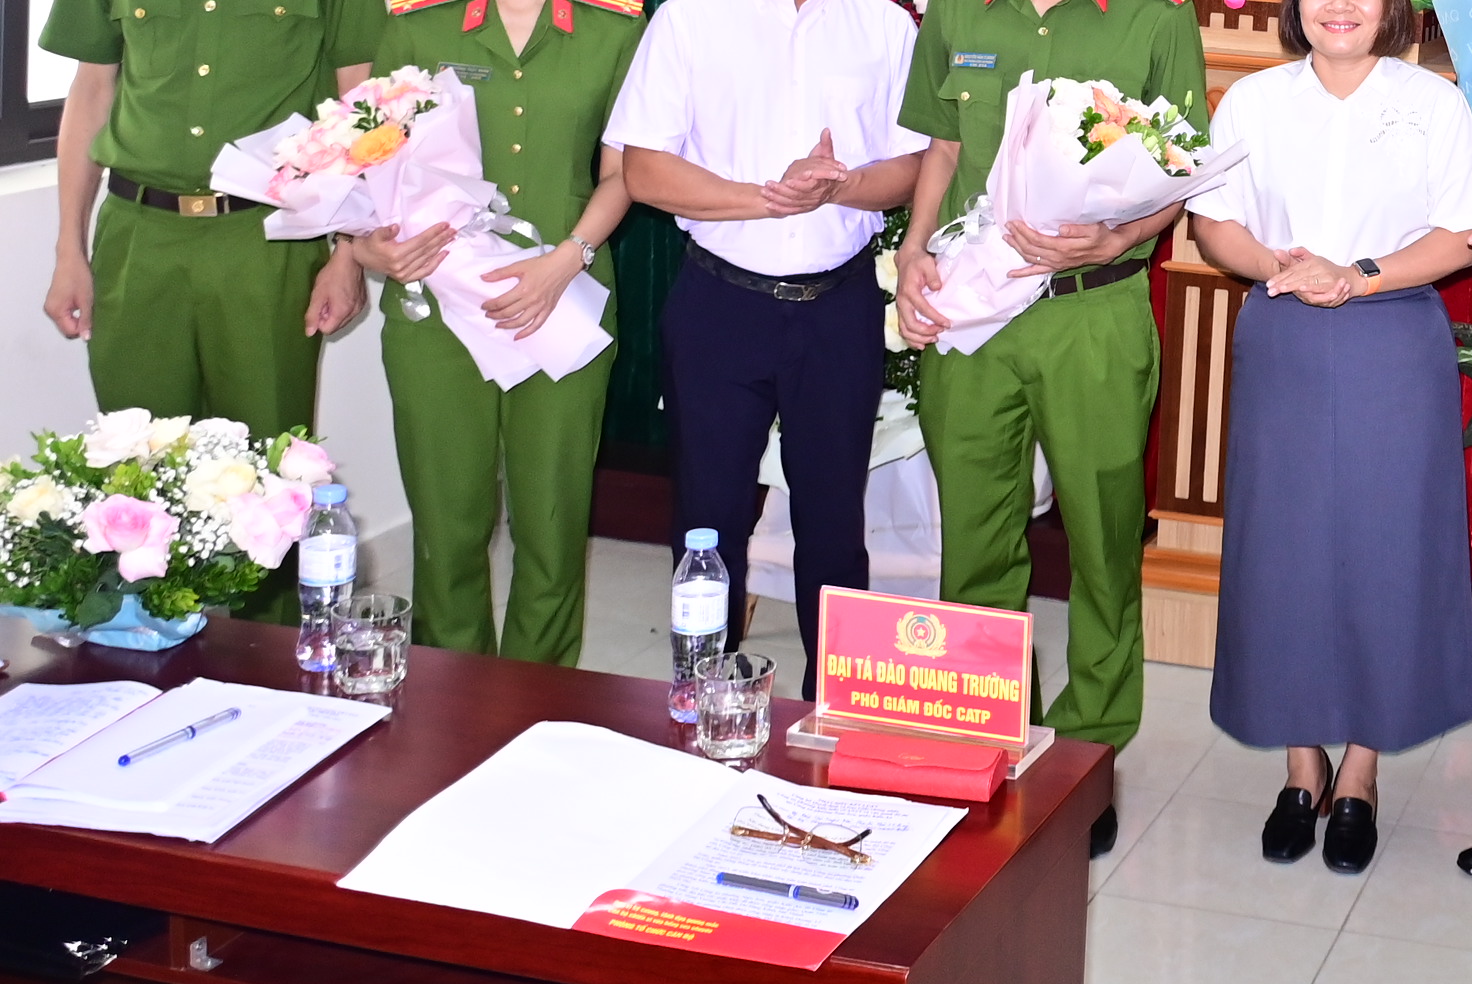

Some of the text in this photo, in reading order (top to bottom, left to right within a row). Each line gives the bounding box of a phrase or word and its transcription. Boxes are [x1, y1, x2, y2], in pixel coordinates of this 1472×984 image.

[827, 654, 852, 682] ĐẠI
[855, 655, 873, 682] TÁ
[909, 666, 958, 694] QUANG
[851, 691, 991, 725] PHÓ GIÁM ĐỐC CATP
